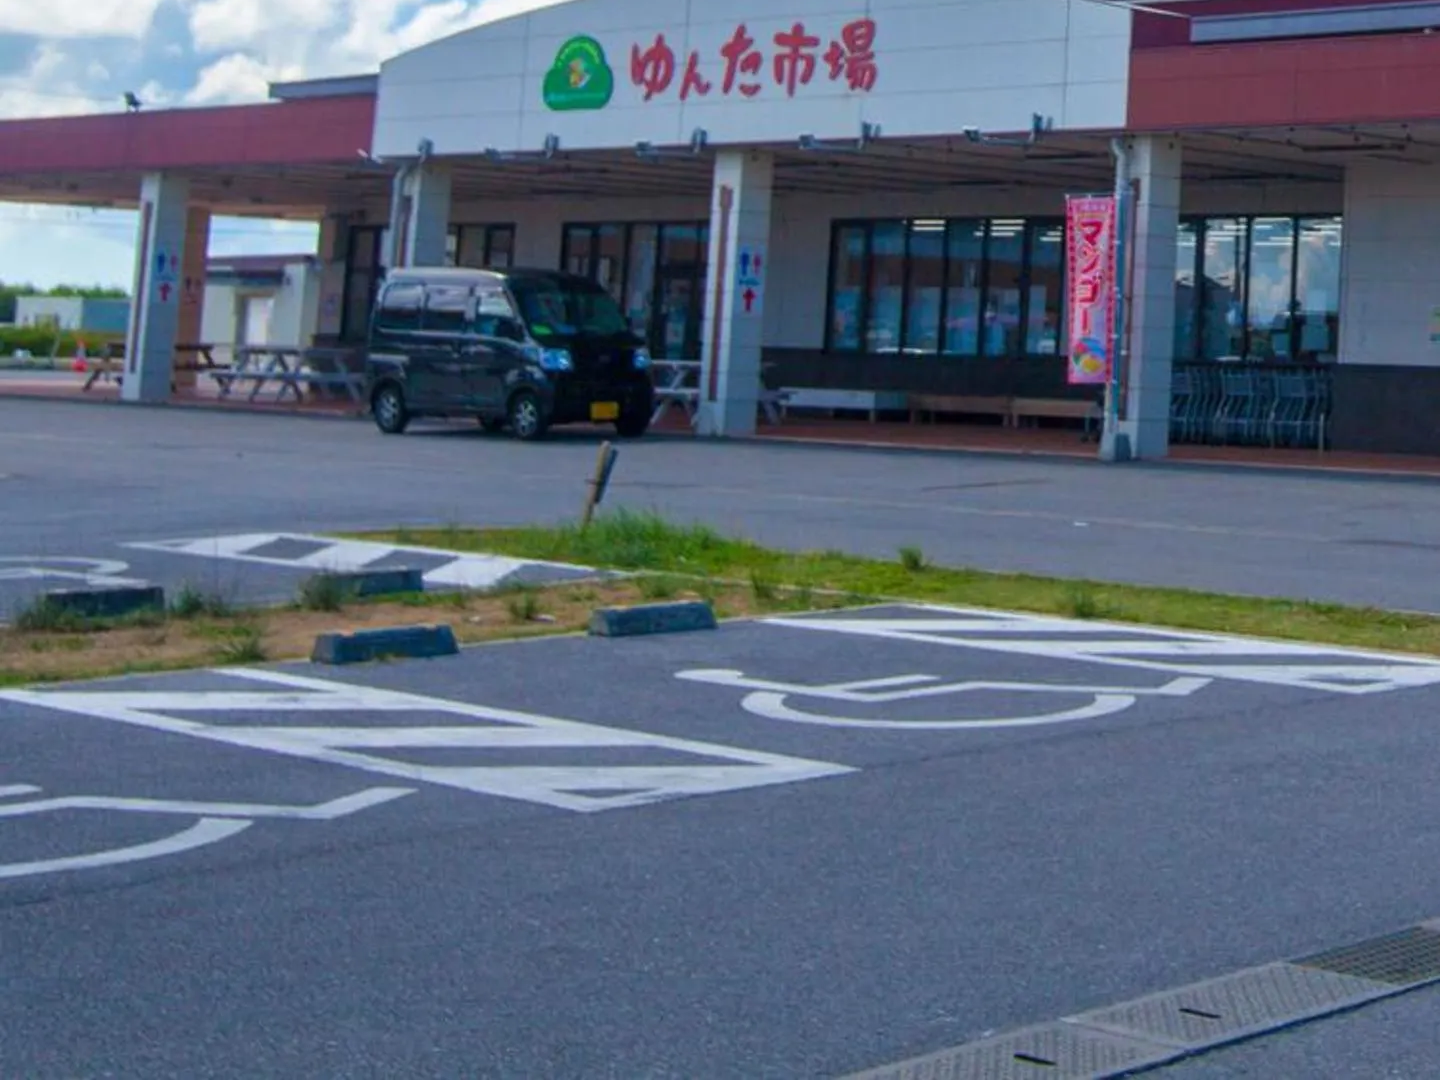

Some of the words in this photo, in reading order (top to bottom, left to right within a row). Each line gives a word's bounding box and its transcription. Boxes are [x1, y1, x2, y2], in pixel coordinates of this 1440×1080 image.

[630, 18, 878, 102] ゆんた市場
[1076, 220, 1104, 336] マンゴー
